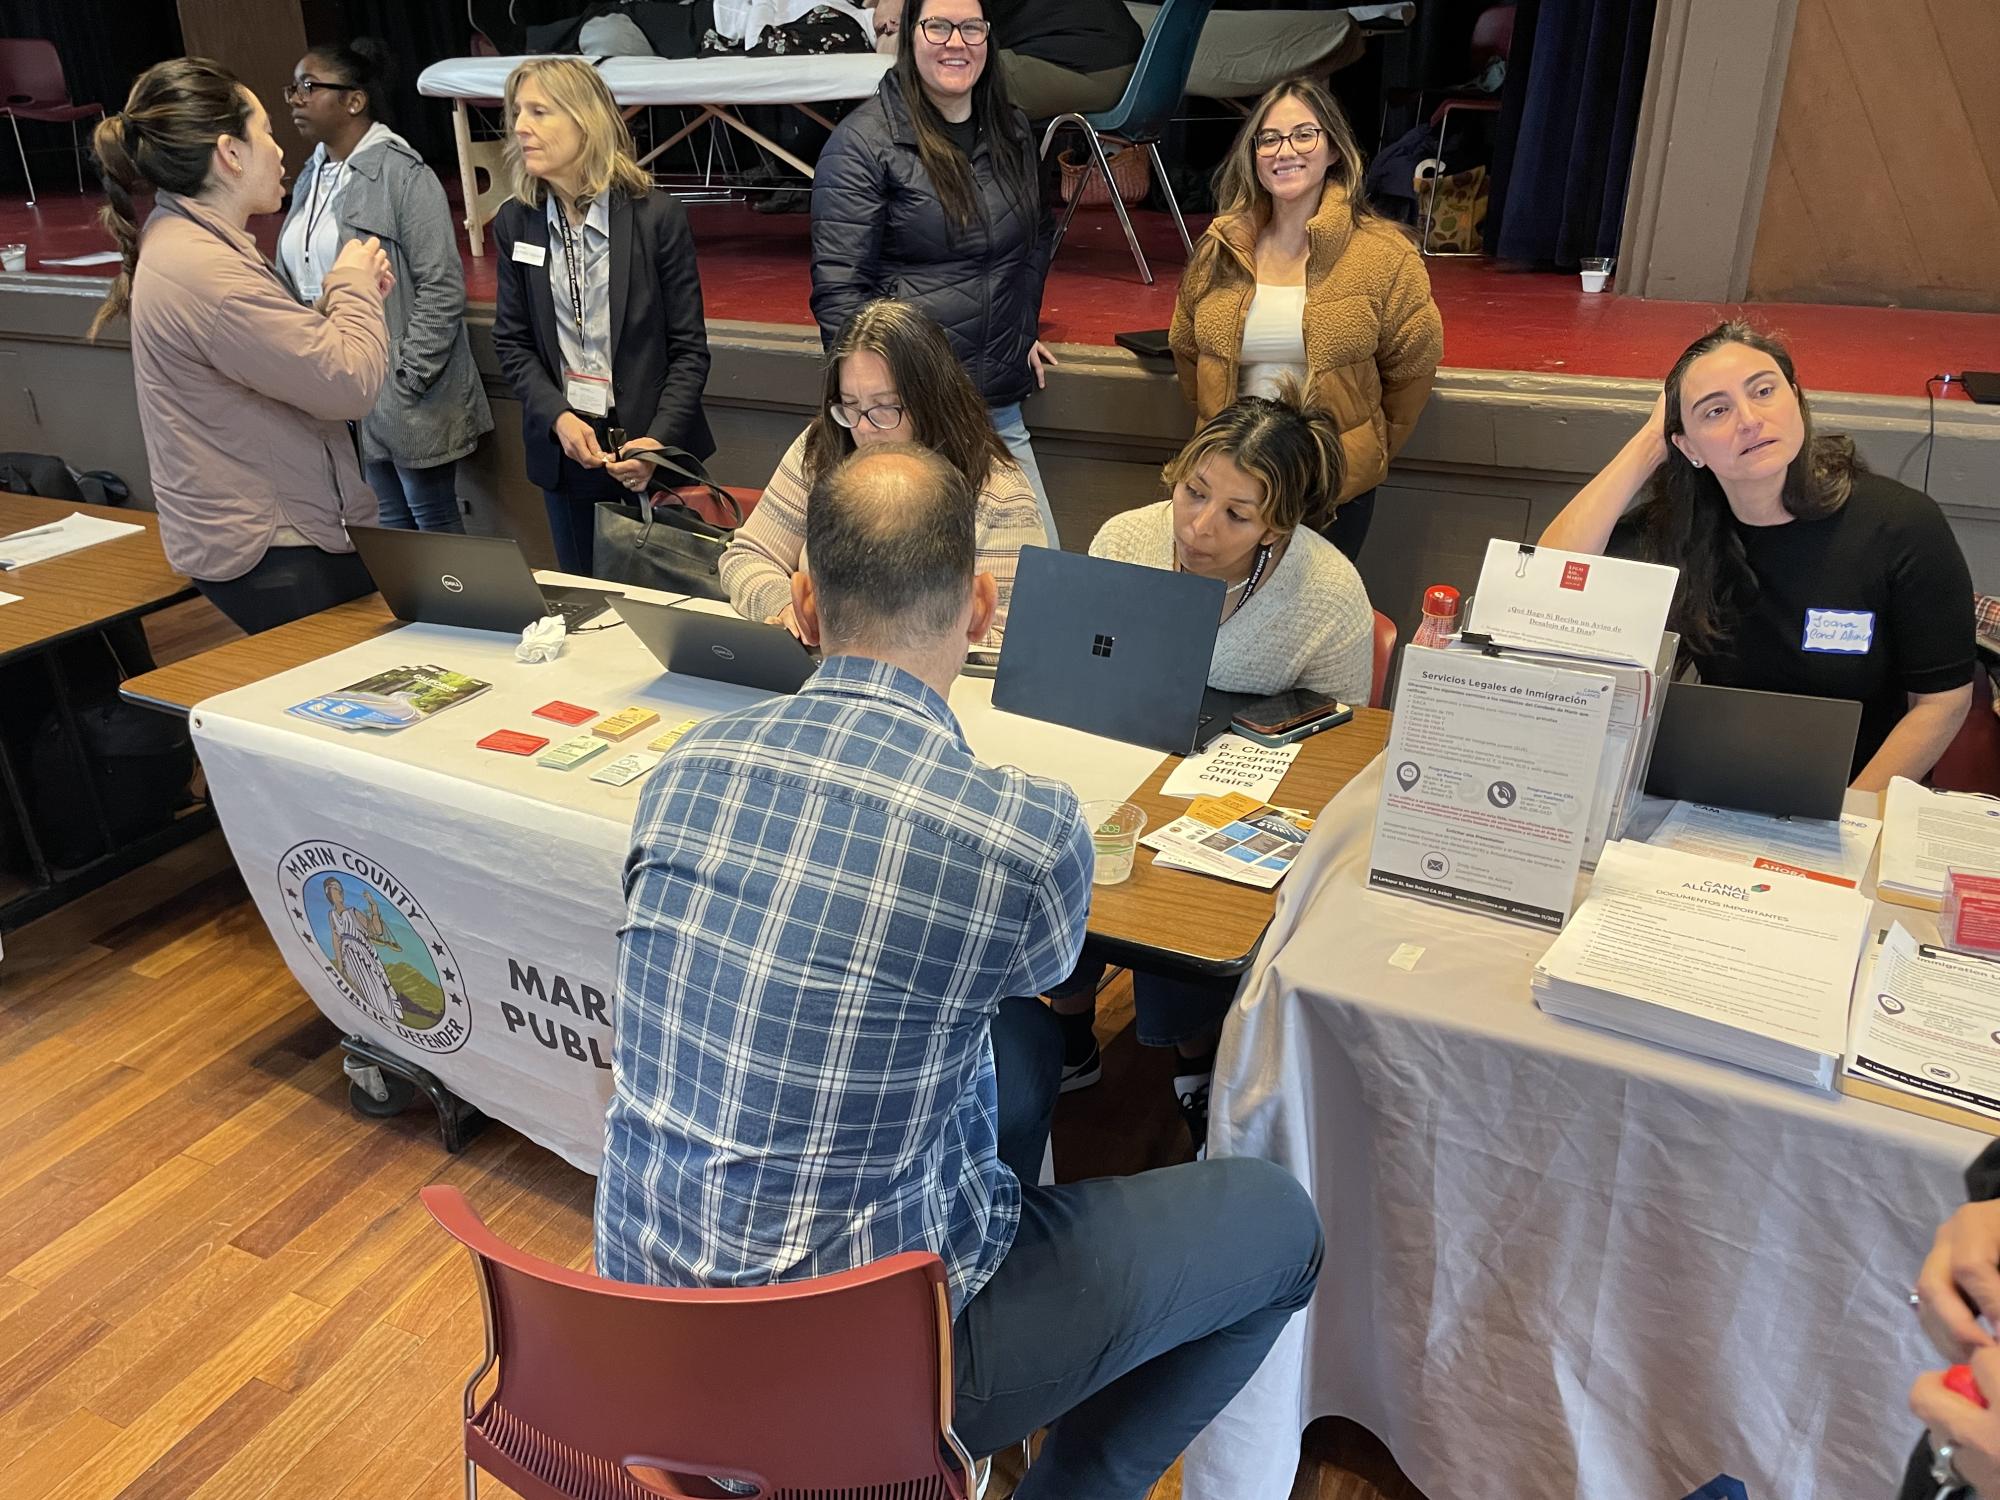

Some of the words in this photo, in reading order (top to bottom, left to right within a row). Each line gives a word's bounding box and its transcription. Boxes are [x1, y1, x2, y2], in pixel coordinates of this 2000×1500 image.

[566, 248, 576, 278] DEFENDER
[1251, 550, 1266, 583] DEFENDER
[1527, 609, 1545, 619] Hago
[1555, 614, 1579, 624] Recibo
[1591, 621, 1612, 631] Aviso
[1529, 618, 1558, 630] Desalojo
[1422, 671, 1466, 685] Servicios
[1469, 679, 1506, 692] Legales
[1510, 686, 1522, 694] de
[1526, 688, 1587, 705] Inmigración
[1218, 752, 1292, 766] Program
[1242, 746, 1290, 757] Clean
[1206, 766, 1263, 780] Office)
[1212, 760, 1283, 774] Defende
[1199, 774, 1253, 787] chairs
[1257, 821, 1291, 835] START
[1760, 864, 1808, 878] AHORA
[286, 848, 336, 881] MARIN
[342, 853, 424, 919] COUNTY
[1682, 882, 1749, 902] ALLIANCE
[1703, 881, 1750, 895] CANAL
[1656, 890, 1720, 906] DOCUMENTOS
[1723, 904, 1789, 922] IMPORTANTES
[508, 958, 614, 1027] MAR
[325, 966, 391, 1029] PUBLIC
[396, 1018, 464, 1048] DEFENDER
[500, 1001, 612, 1070] PUBL
